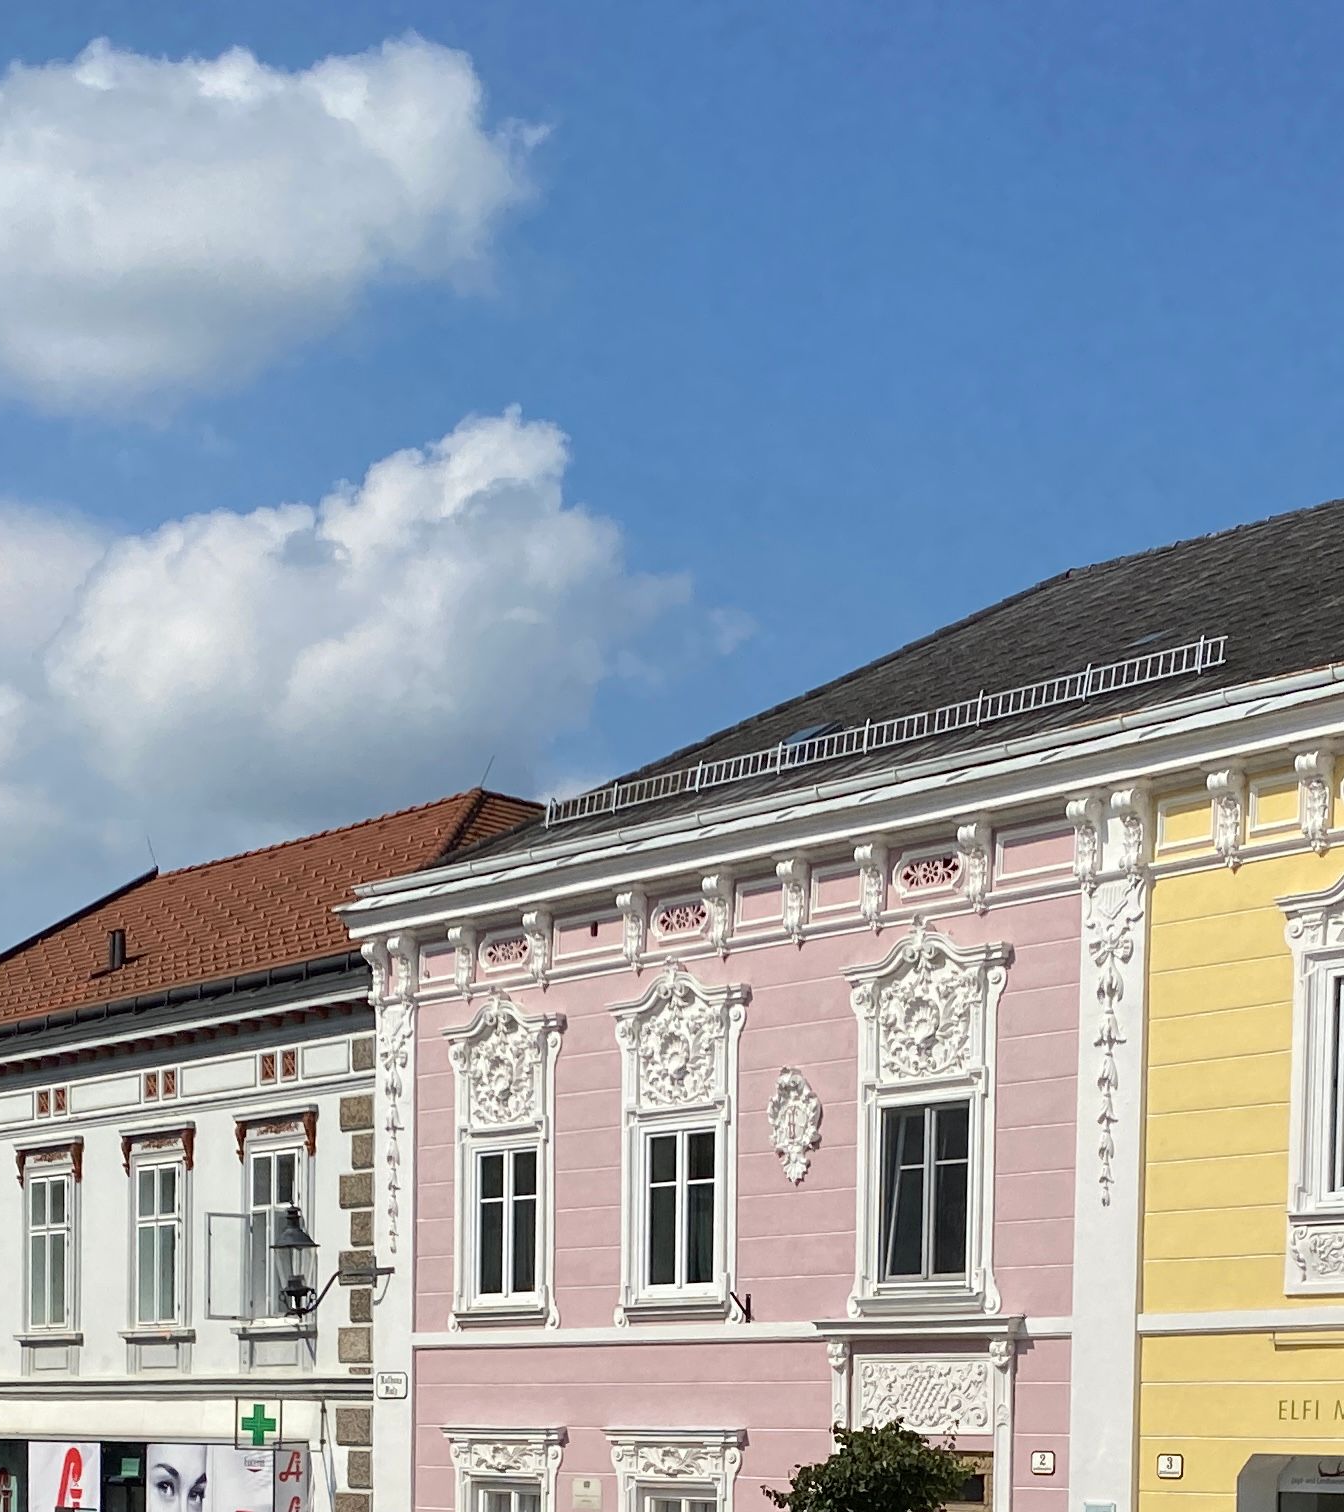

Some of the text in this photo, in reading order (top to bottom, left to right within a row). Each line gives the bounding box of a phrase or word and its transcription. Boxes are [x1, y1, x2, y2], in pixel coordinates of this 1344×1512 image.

[1278, 1400, 1319, 1421] ELFI
[1039, 1454, 1046, 1466] 2
[1166, 1457, 1173, 1470] 3
